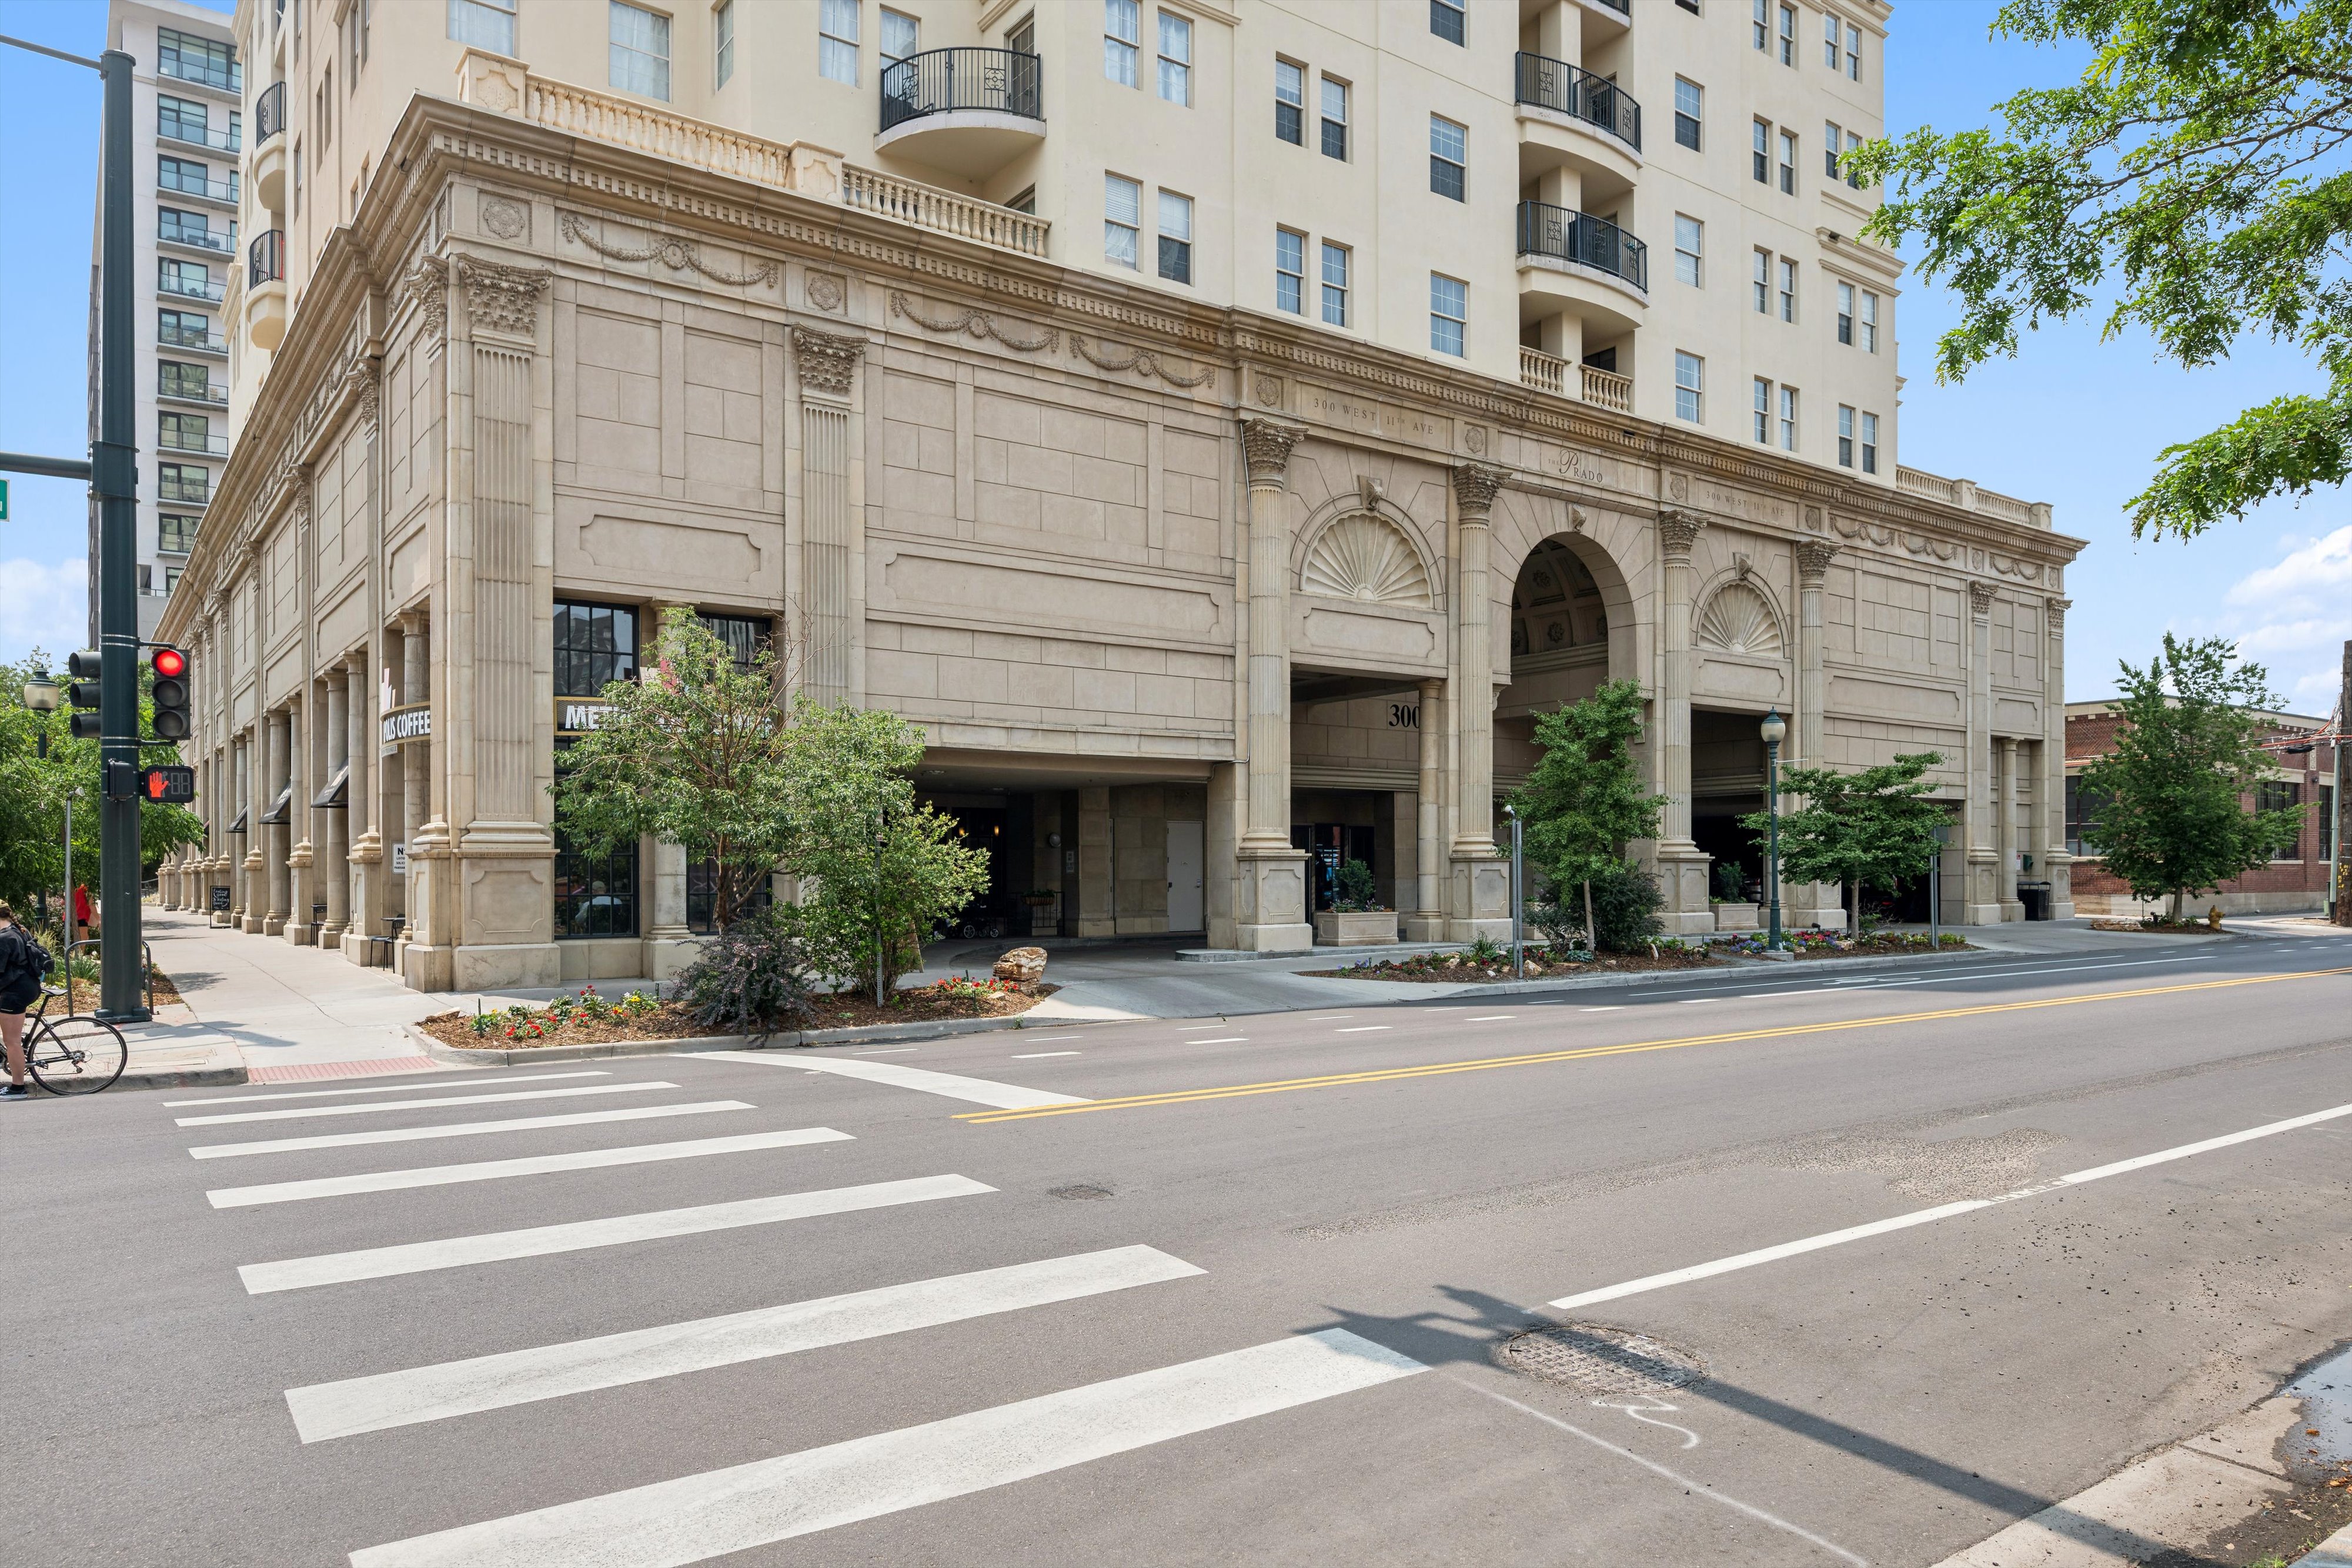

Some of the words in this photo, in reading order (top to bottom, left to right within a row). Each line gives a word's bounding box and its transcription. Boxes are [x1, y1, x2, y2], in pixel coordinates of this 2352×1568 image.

[1314, 398, 1335, 412] 300
[1342, 404, 1376, 421] WEST
[1413, 422, 1434, 434] AVE
[1706, 491, 1720, 501] 300
[1725, 496, 1747, 507] WEST
[1771, 507, 1785, 516] AVE
[397, 710, 430, 738] COFFEE
[1389, 704, 1419, 728] 300
